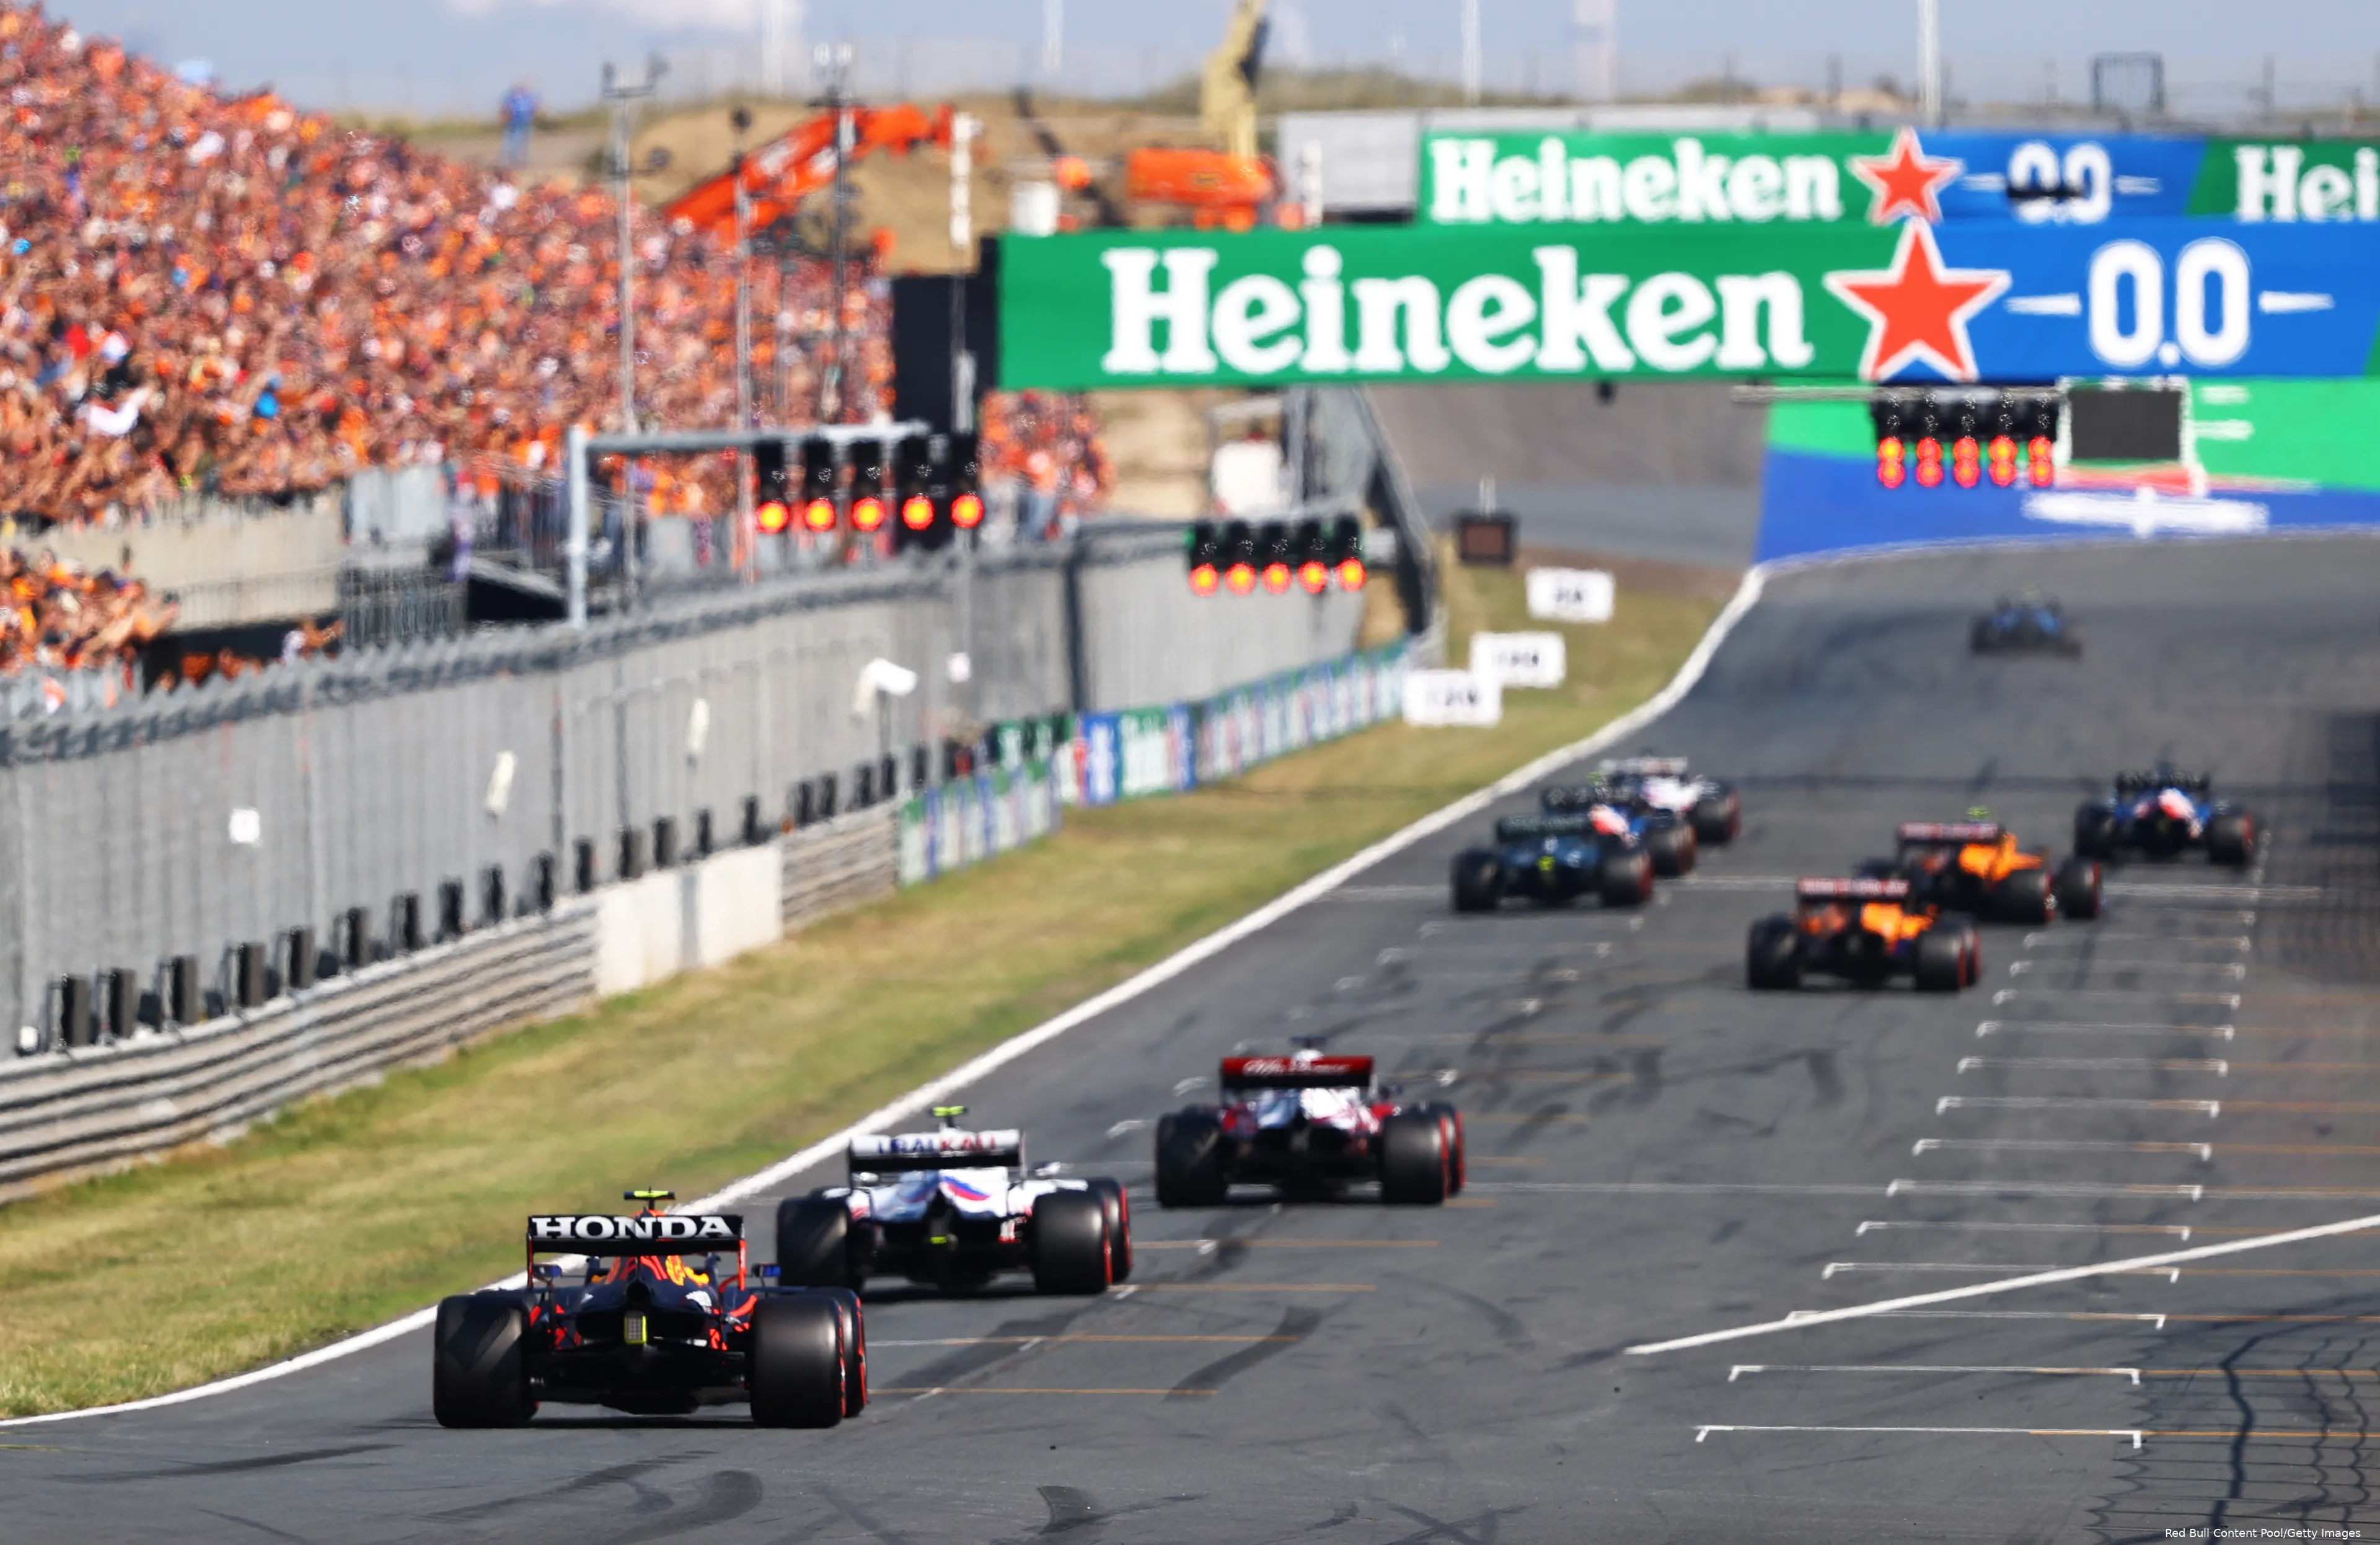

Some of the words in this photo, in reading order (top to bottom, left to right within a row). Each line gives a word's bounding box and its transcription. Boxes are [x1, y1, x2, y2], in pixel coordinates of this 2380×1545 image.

[1430, 138, 1843, 224] Heineken
[1102, 245, 1814, 373] Heineken
[2088, 237, 2251, 368] 0.0
[532, 1215, 735, 1239] HONDA
